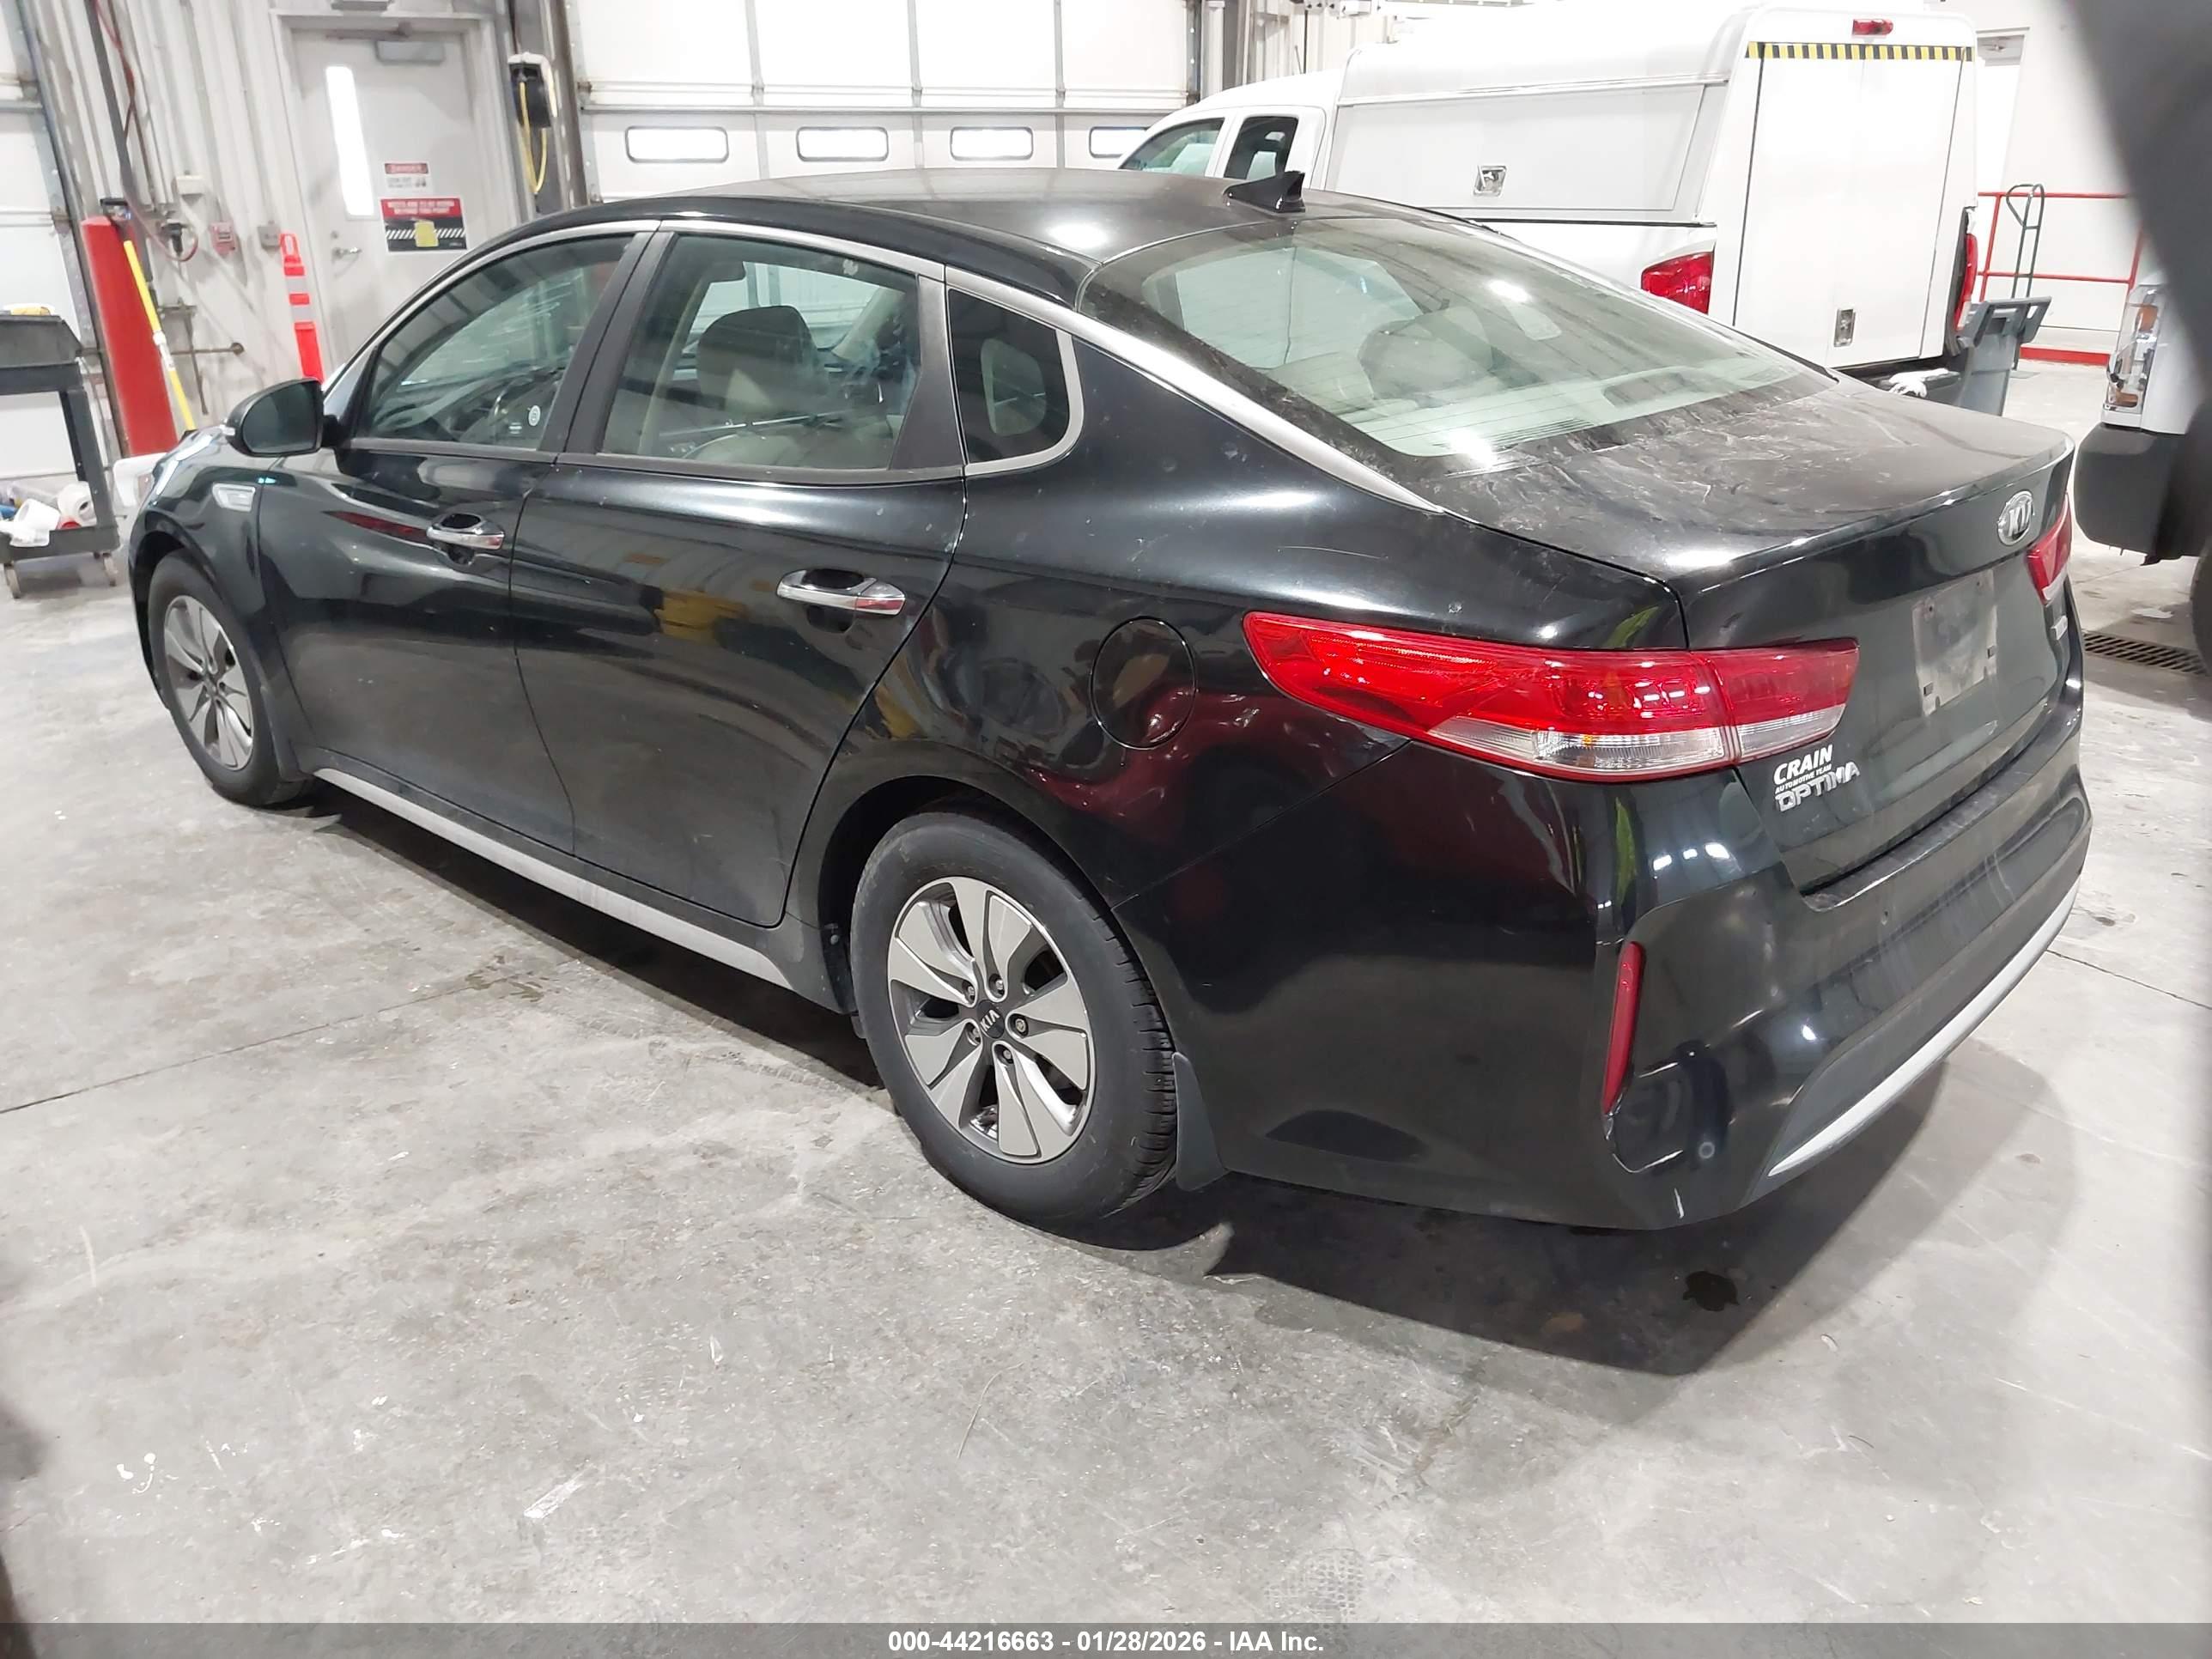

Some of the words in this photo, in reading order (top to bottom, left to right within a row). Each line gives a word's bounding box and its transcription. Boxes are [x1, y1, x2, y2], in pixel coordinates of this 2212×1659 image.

[1773, 744, 1833, 785] CRAIN
[1774, 770, 1815, 794] AUTOMOTIVE
[1815, 763, 1832, 776] TEAM
[1774, 761, 1860, 811] OPTIMA
[980, 1009, 1000, 1032] KIA
